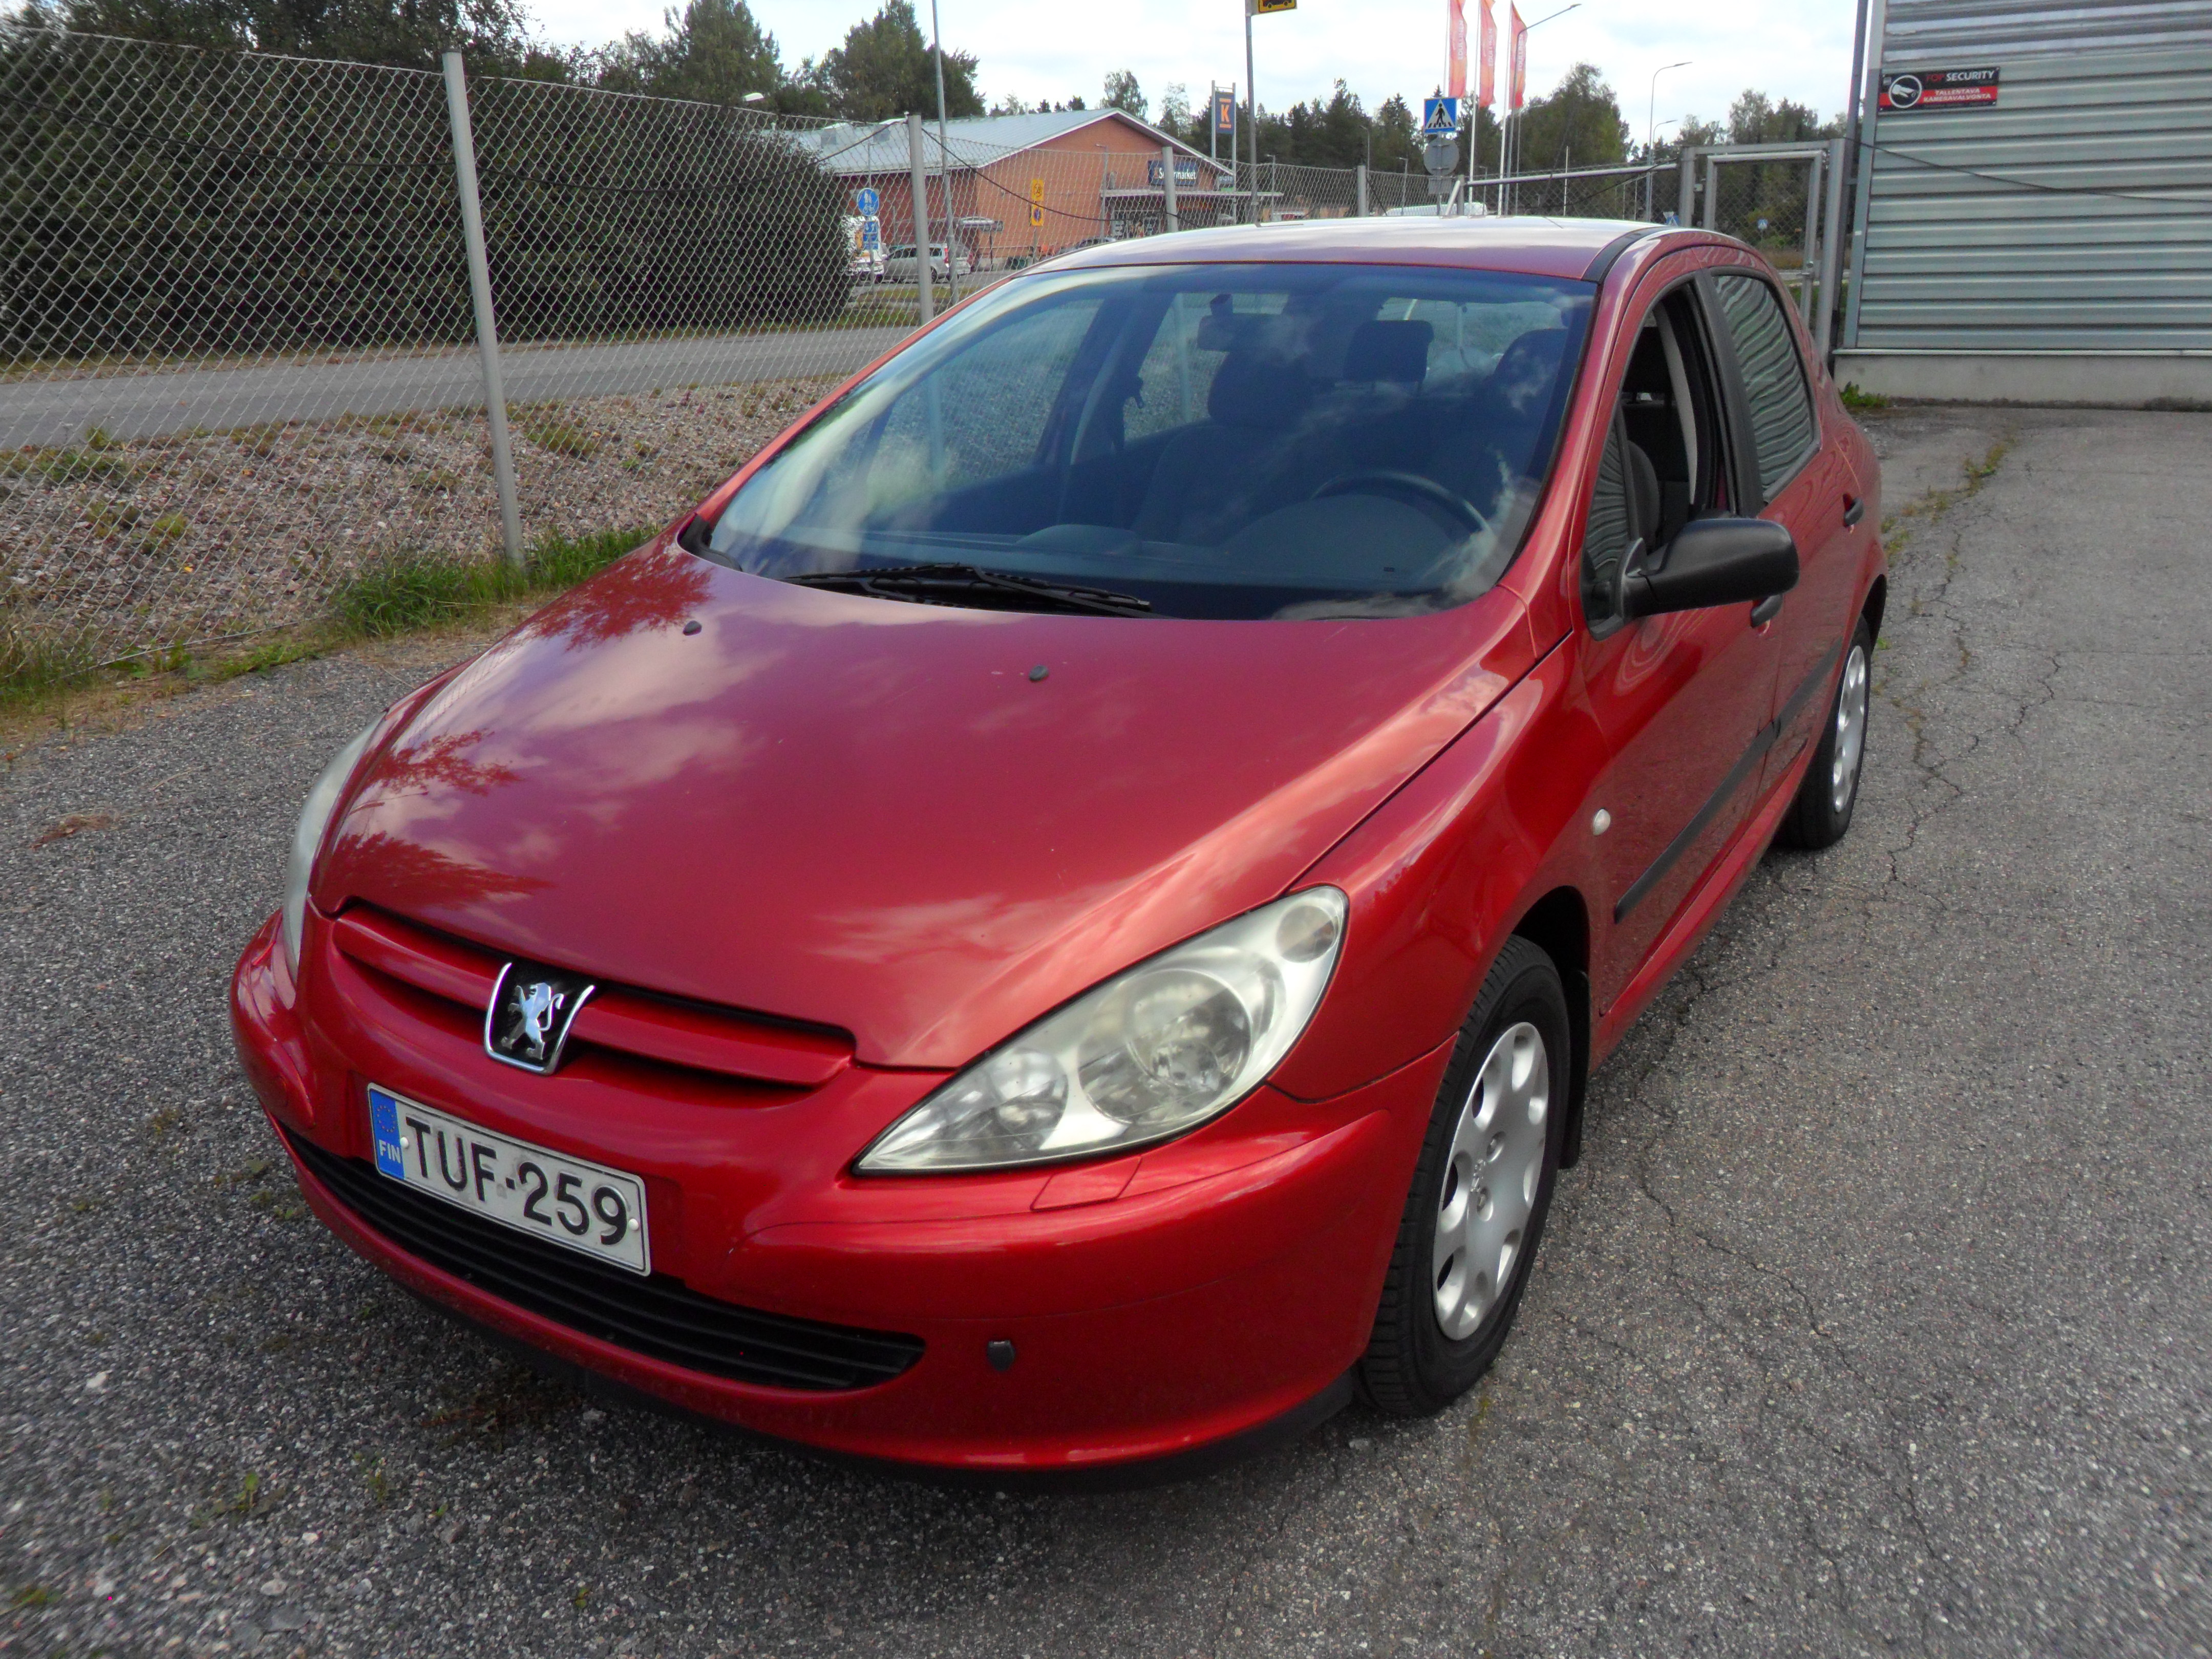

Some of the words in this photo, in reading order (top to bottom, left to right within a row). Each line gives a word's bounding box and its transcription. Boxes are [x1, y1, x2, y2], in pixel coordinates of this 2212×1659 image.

[1946, 71, 1994, 81] SECURITY
[1923, 93, 1991, 102] KAMERAVALVONTA
[1221, 104, 1229, 123] K
[1159, 167, 1196, 180] Srmarket
[378, 1139, 401, 1164] FIN
[406, 1116, 628, 1246] TUF-259
